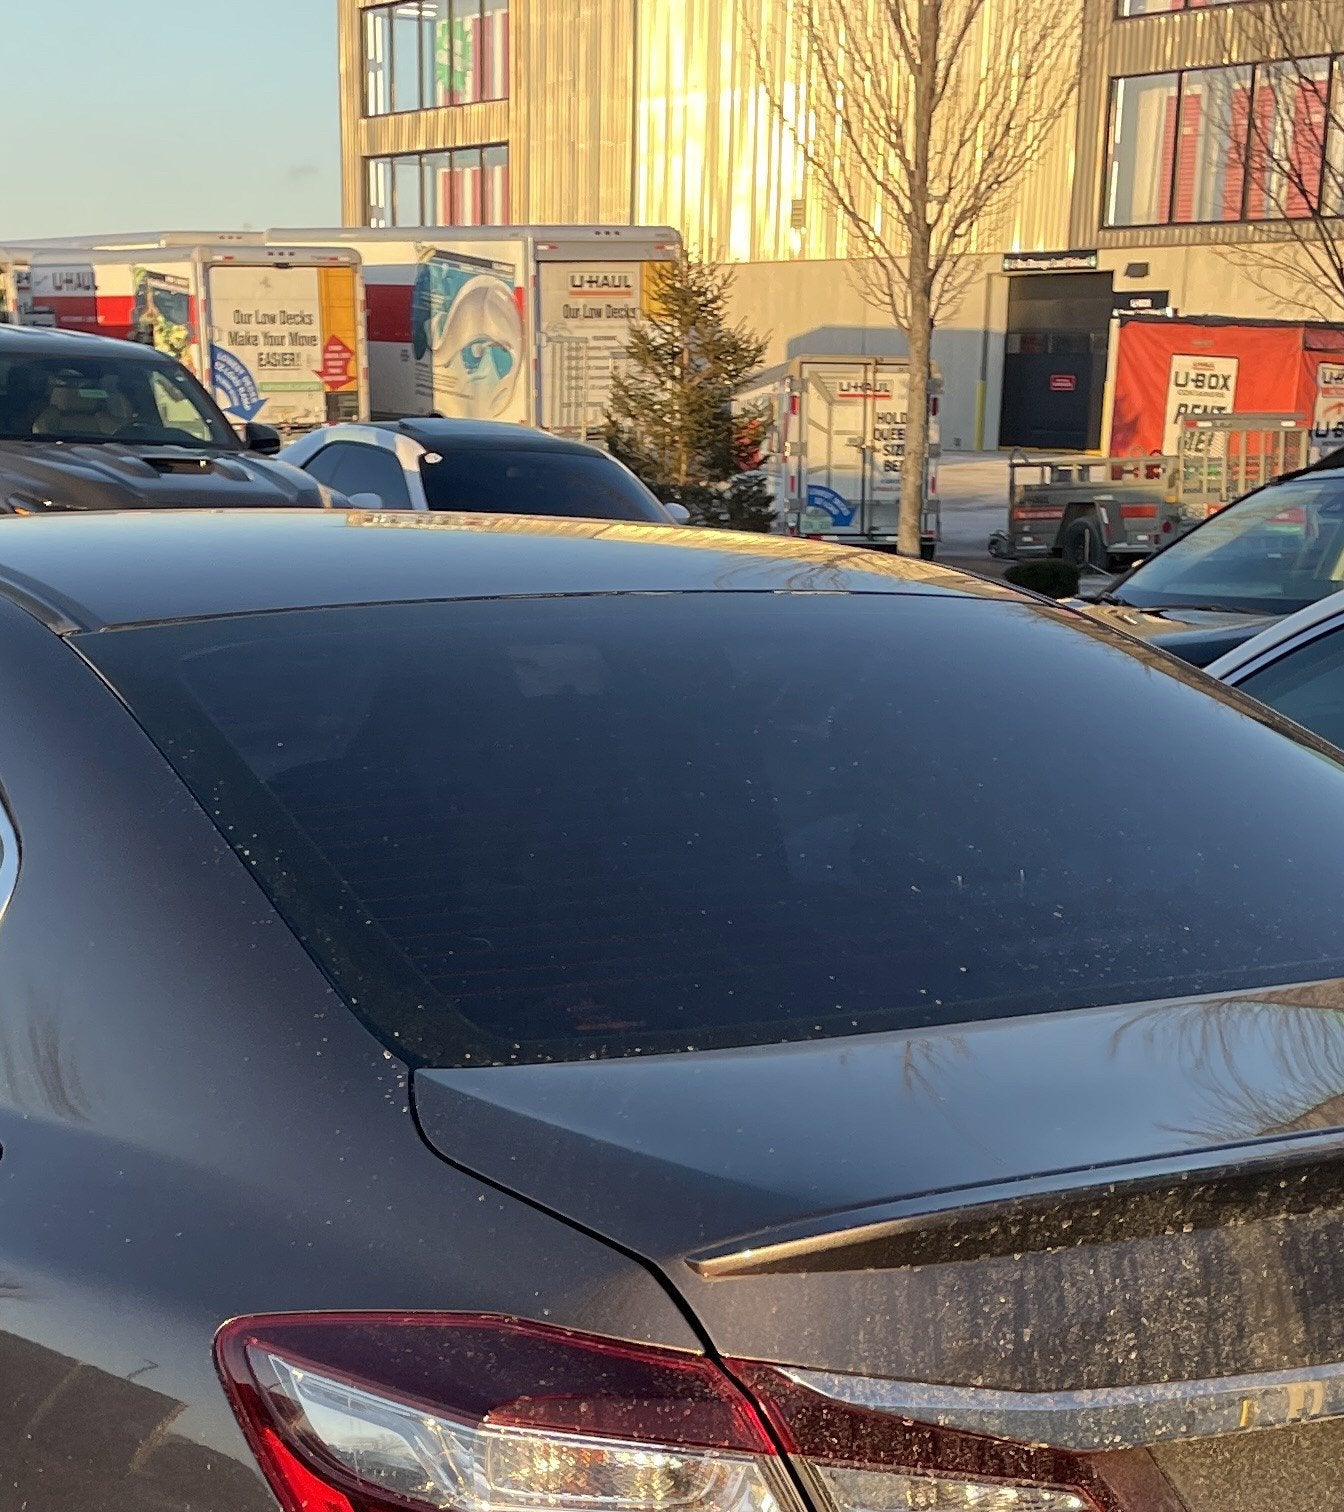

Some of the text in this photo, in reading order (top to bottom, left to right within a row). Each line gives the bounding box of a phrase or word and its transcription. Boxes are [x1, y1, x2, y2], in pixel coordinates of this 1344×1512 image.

[570, 274, 632, 288] U-HAUL
[233, 309, 314, 325] Our Low Decks
[563, 304, 580, 319] Our
[583, 304, 602, 319] Low
[228, 331, 320, 347] Make Your Move
[1174, 370, 1231, 391] U-BOX
[876, 411, 907, 425] HOLD
[874, 427, 906, 441] QUEE
